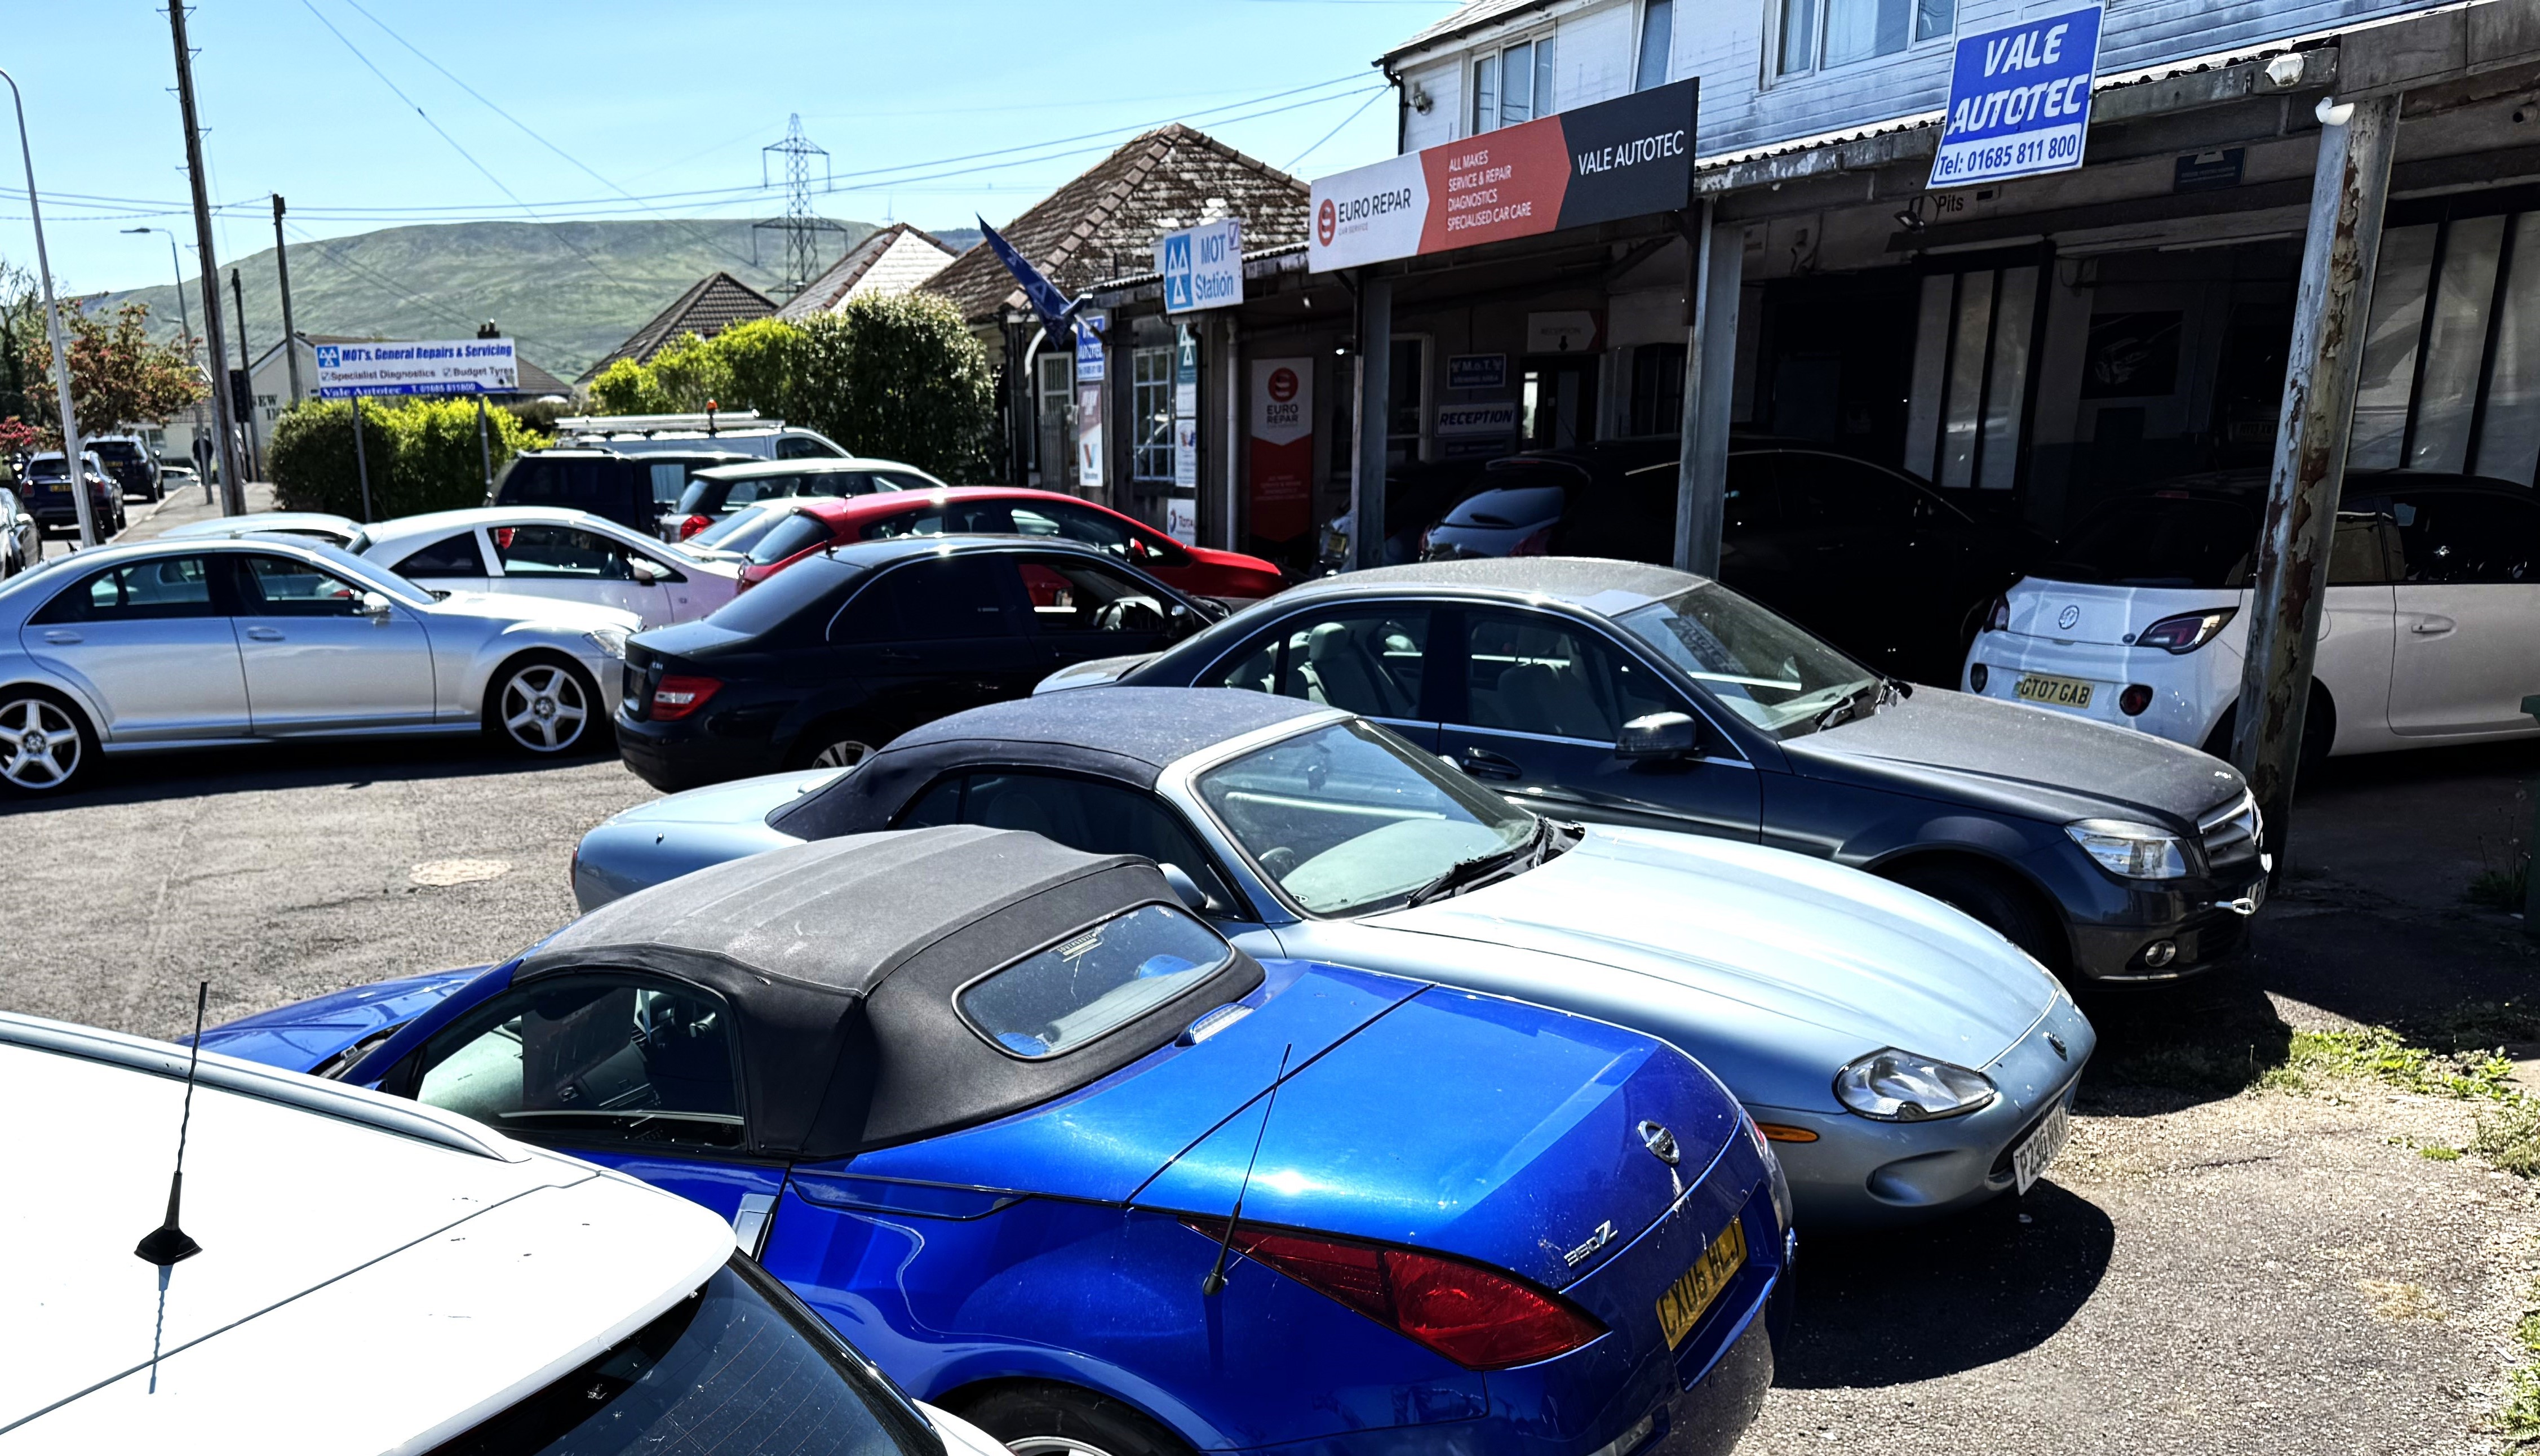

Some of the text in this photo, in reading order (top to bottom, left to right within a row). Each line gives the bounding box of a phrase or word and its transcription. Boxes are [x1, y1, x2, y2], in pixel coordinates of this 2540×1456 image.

[1984, 23, 2069, 77] VALE
[1947, 73, 2089, 136] AUTOTEC
[1449, 149, 1488, 173] ALL MAKES
[1578, 130, 1685, 176] VALE AUTOTEC
[1939, 135, 2076, 175] Tel: 01685 811 800
[1448, 165, 1511, 193] SERVICE & REPAIR
[1339, 188, 1411, 223] EURO REPAR
[1448, 188, 1497, 212] DIAGNOSTICS
[1939, 194, 1963, 212] Pits
[1447, 201, 1532, 232] SPECIALISED CAR CARE
[1201, 234, 1226, 264] MOT
[1195, 271, 1233, 300] Station
[375, 347, 414, 360] General
[416, 347, 454, 359] Repairs
[456, 347, 463, 358] &
[466, 344, 512, 358] Servicing
[331, 370, 377, 382] Specialist
[380, 369, 435, 380] Diagnostics
[454, 367, 487, 378] Budget
[322, 388, 351, 397] Vale
[354, 386, 401, 396] Autotec
[1267, 405, 1298, 415] EURO
[1267, 415, 1298, 425] REPAR
[1440, 410, 1513, 426] RECEPTION
[2021, 678, 2090, 704] GT07 GAB
[1564, 1220, 1618, 1267] 350Z
